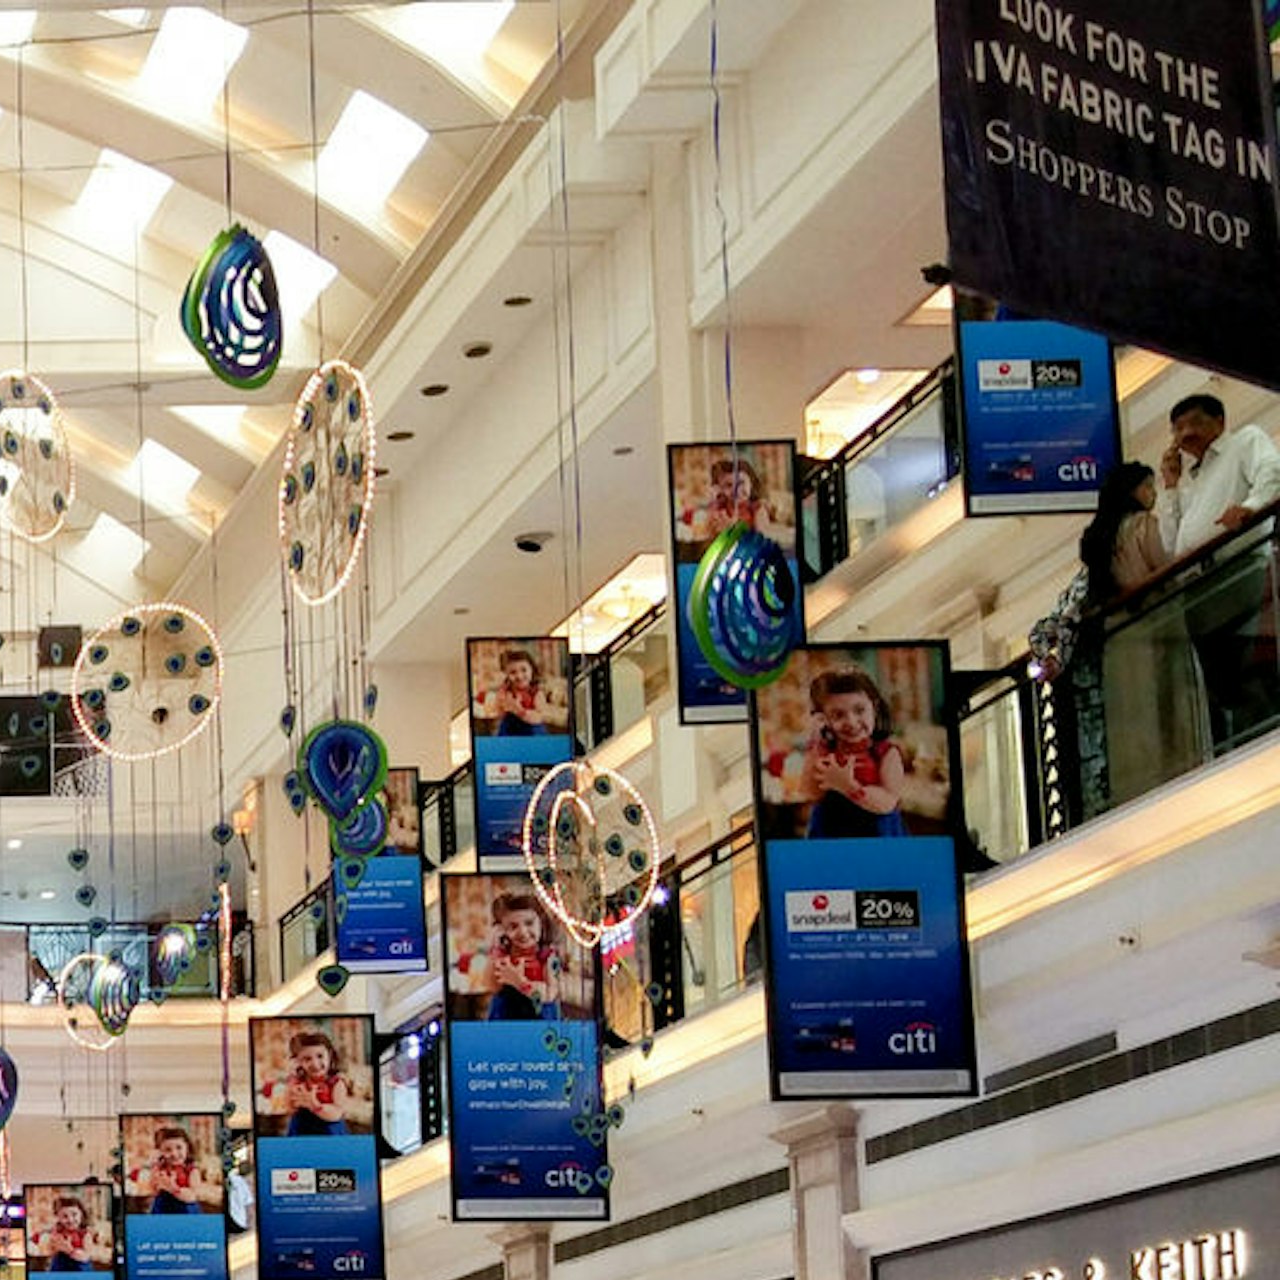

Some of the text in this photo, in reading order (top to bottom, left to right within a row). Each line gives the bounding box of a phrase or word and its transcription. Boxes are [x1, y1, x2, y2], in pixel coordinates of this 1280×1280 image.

[1086, 21, 1147, 83] FOR
[1154, 51, 1222, 109] THE
[966, 39, 1273, 182] IVA FABRIC TAG IN
[986, 118, 1250, 248] SHOPPERS STOP
[1036, 366, 1077, 381] 20%
[1057, 461, 1097, 482] citi
[862, 899, 914, 918] 20%
[792, 912, 851, 926] snapdeal
[389, 941, 413, 954] citi
[888, 1029, 936, 1053] citi
[468, 1061, 488, 1072] Let
[492, 1063, 518, 1073] your
[521, 1062, 554, 1072] loved
[500, 1078, 526, 1089] with
[333, 1255, 364, 1271] citi
